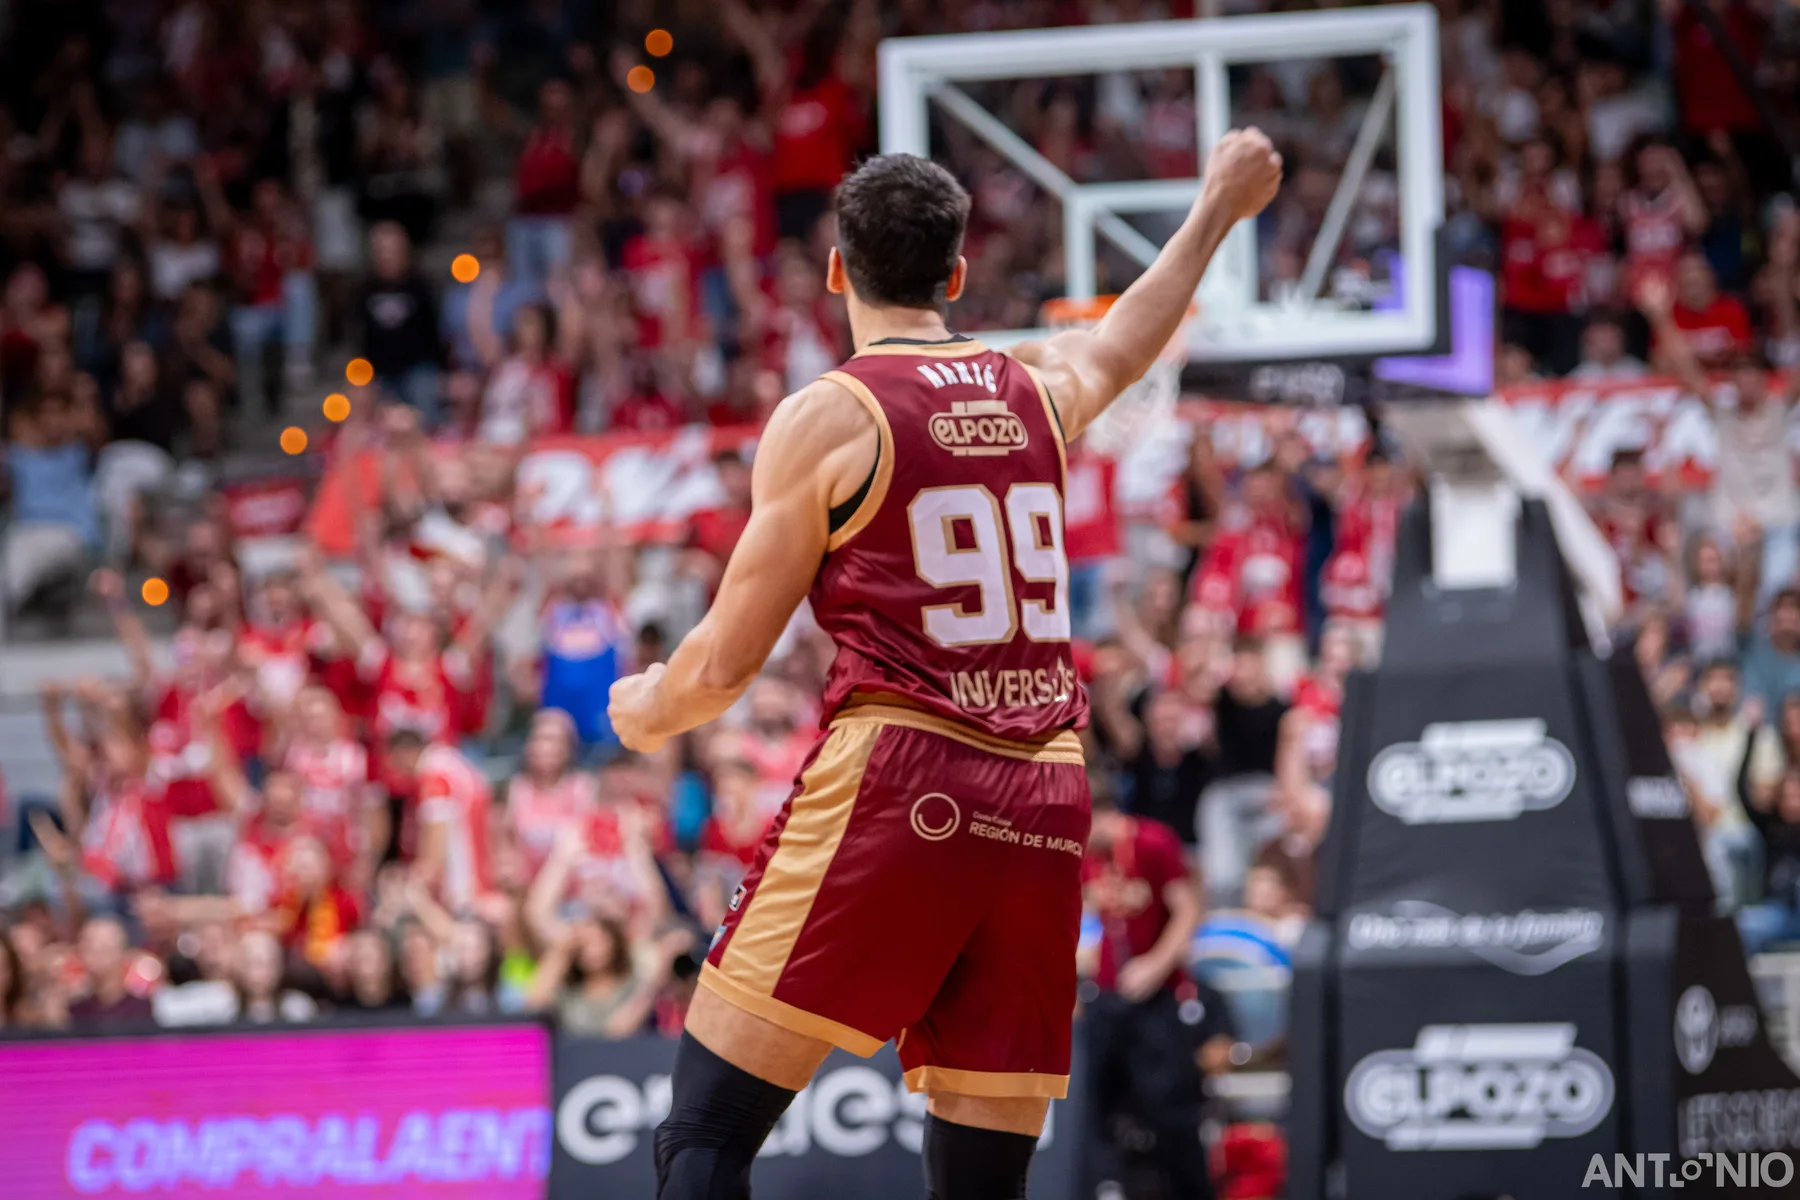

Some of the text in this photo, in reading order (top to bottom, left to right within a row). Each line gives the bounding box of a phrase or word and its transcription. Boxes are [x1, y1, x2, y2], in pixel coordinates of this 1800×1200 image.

[906, 482, 1071, 648] 99
[968, 821, 1020, 844] REGIÓN
[1022, 833, 1043, 848] DE
